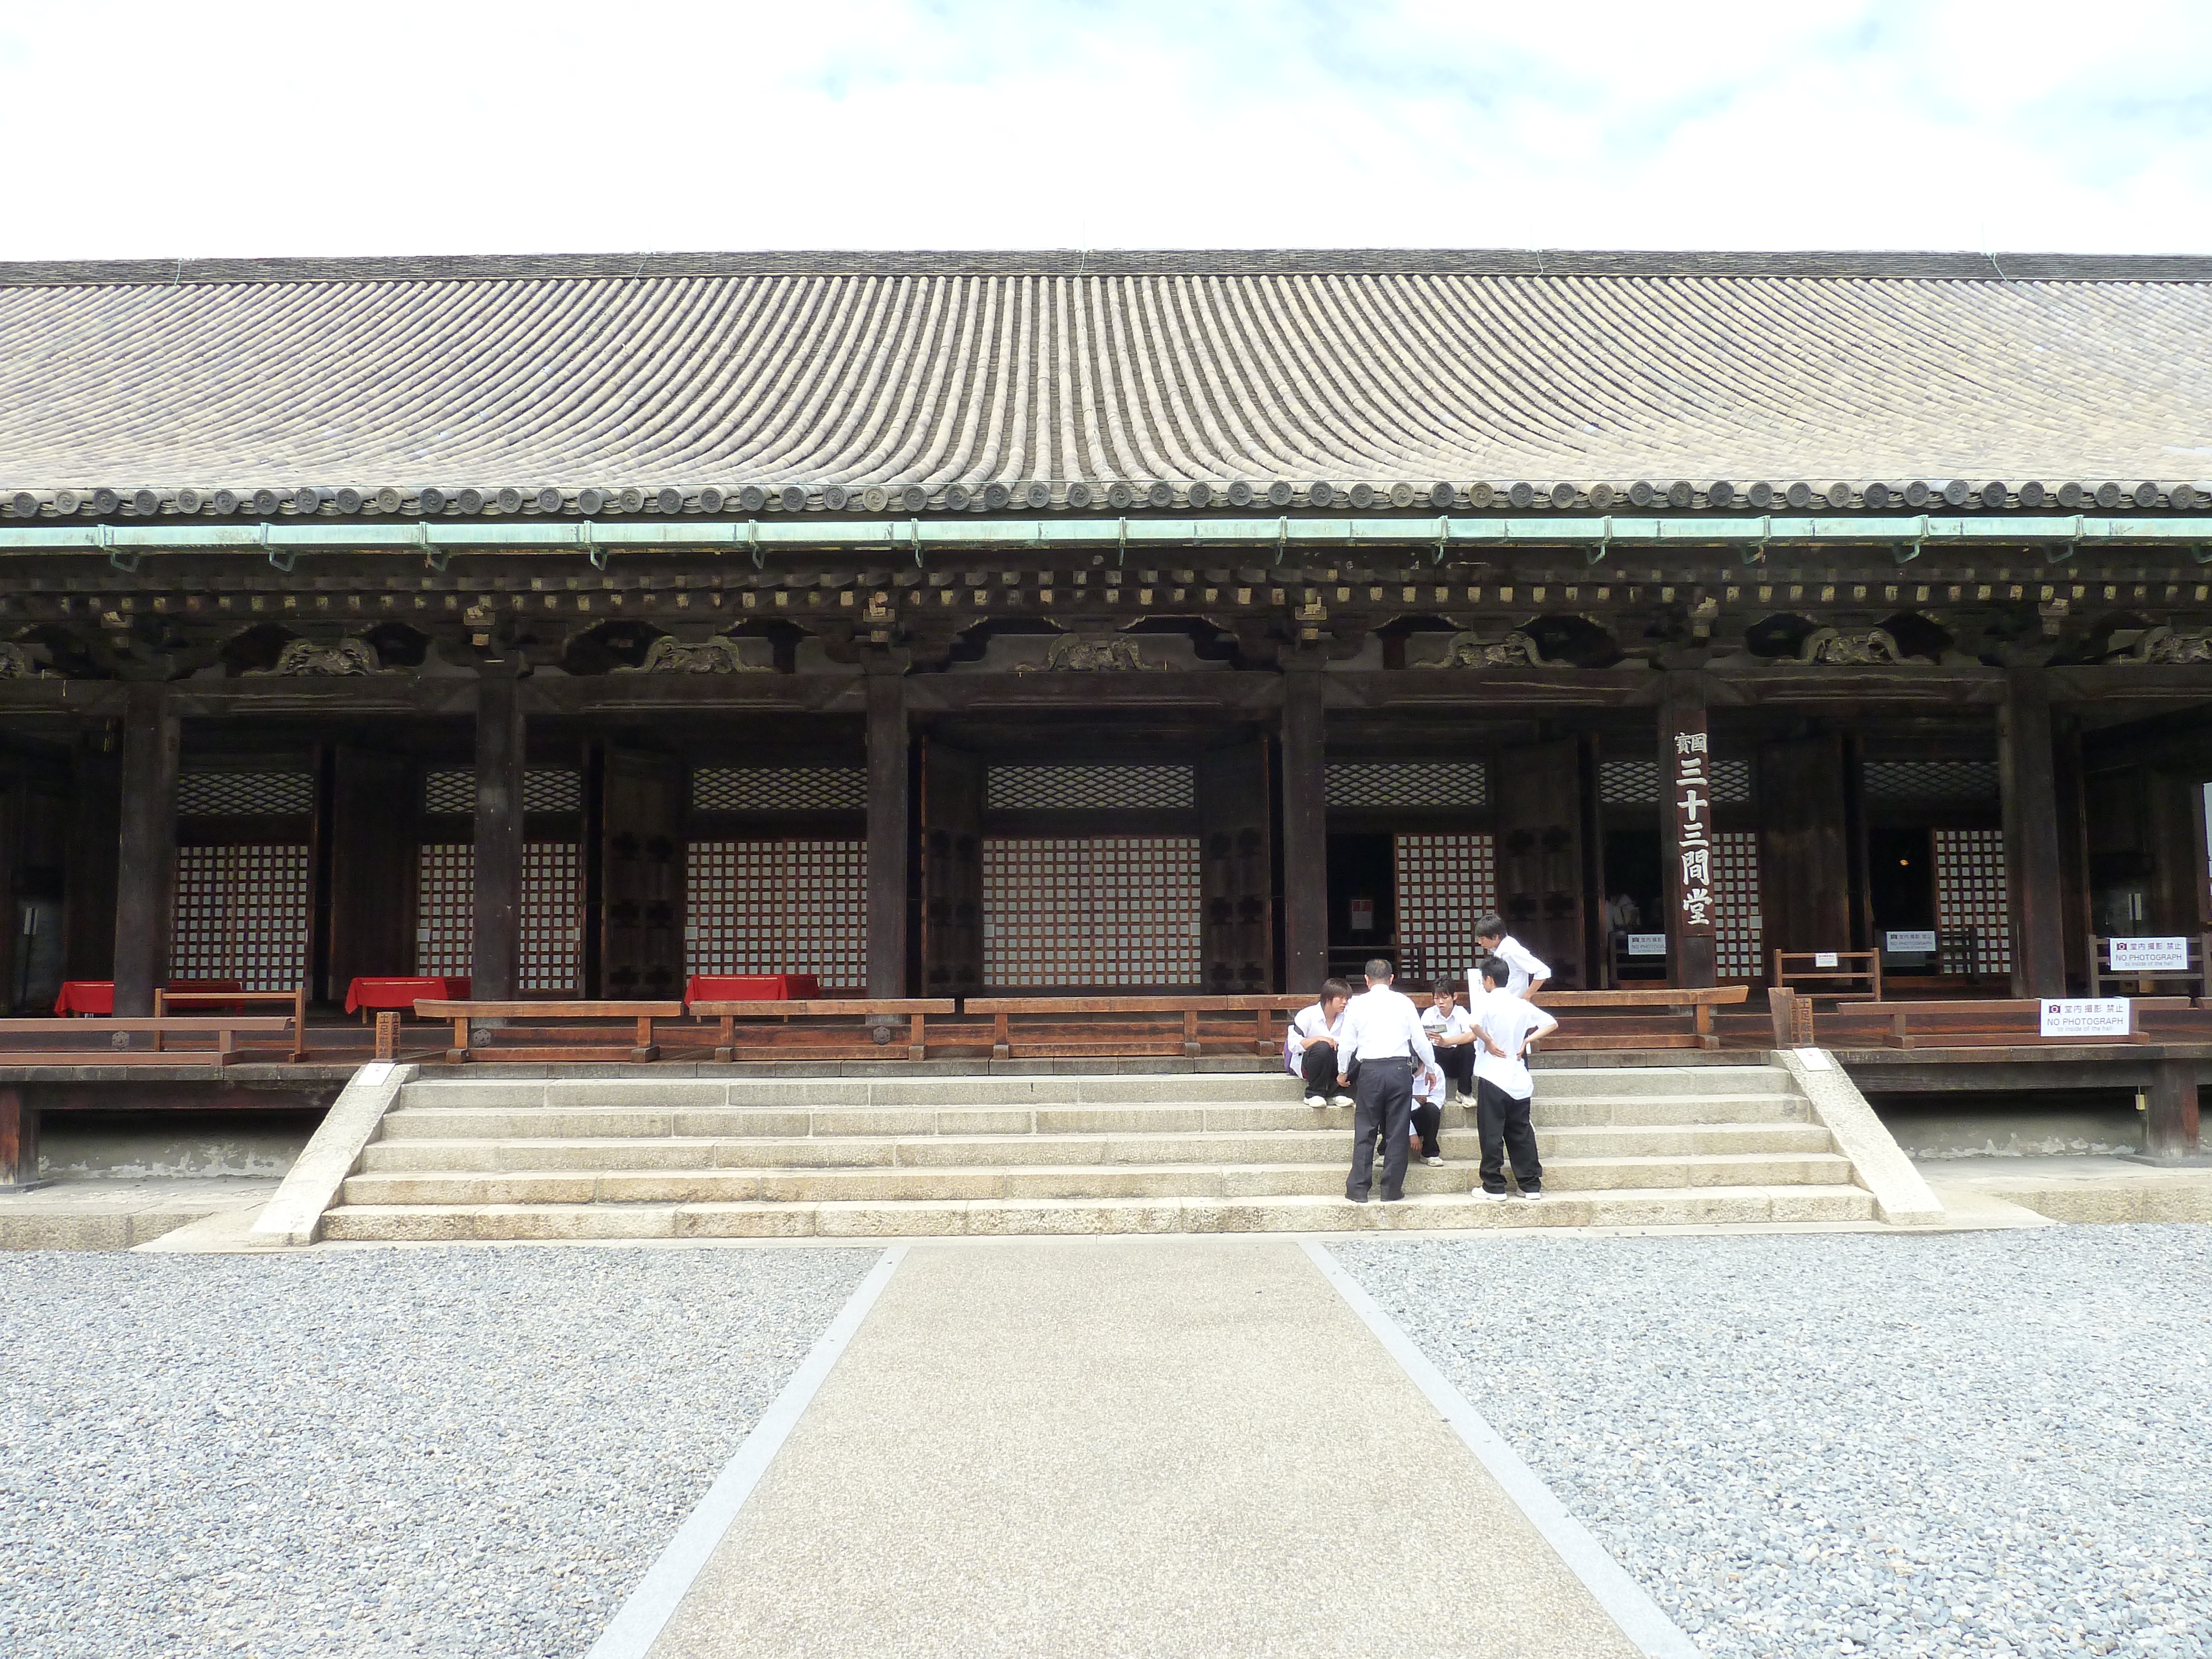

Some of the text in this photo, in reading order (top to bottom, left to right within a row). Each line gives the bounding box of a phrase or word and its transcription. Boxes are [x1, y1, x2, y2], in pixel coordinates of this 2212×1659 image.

[1676, 758, 1713, 925] 三十三間堂
[2084, 1004, 2102, 1013] 撮影
[2106, 1004, 2124, 1013] 禁止
